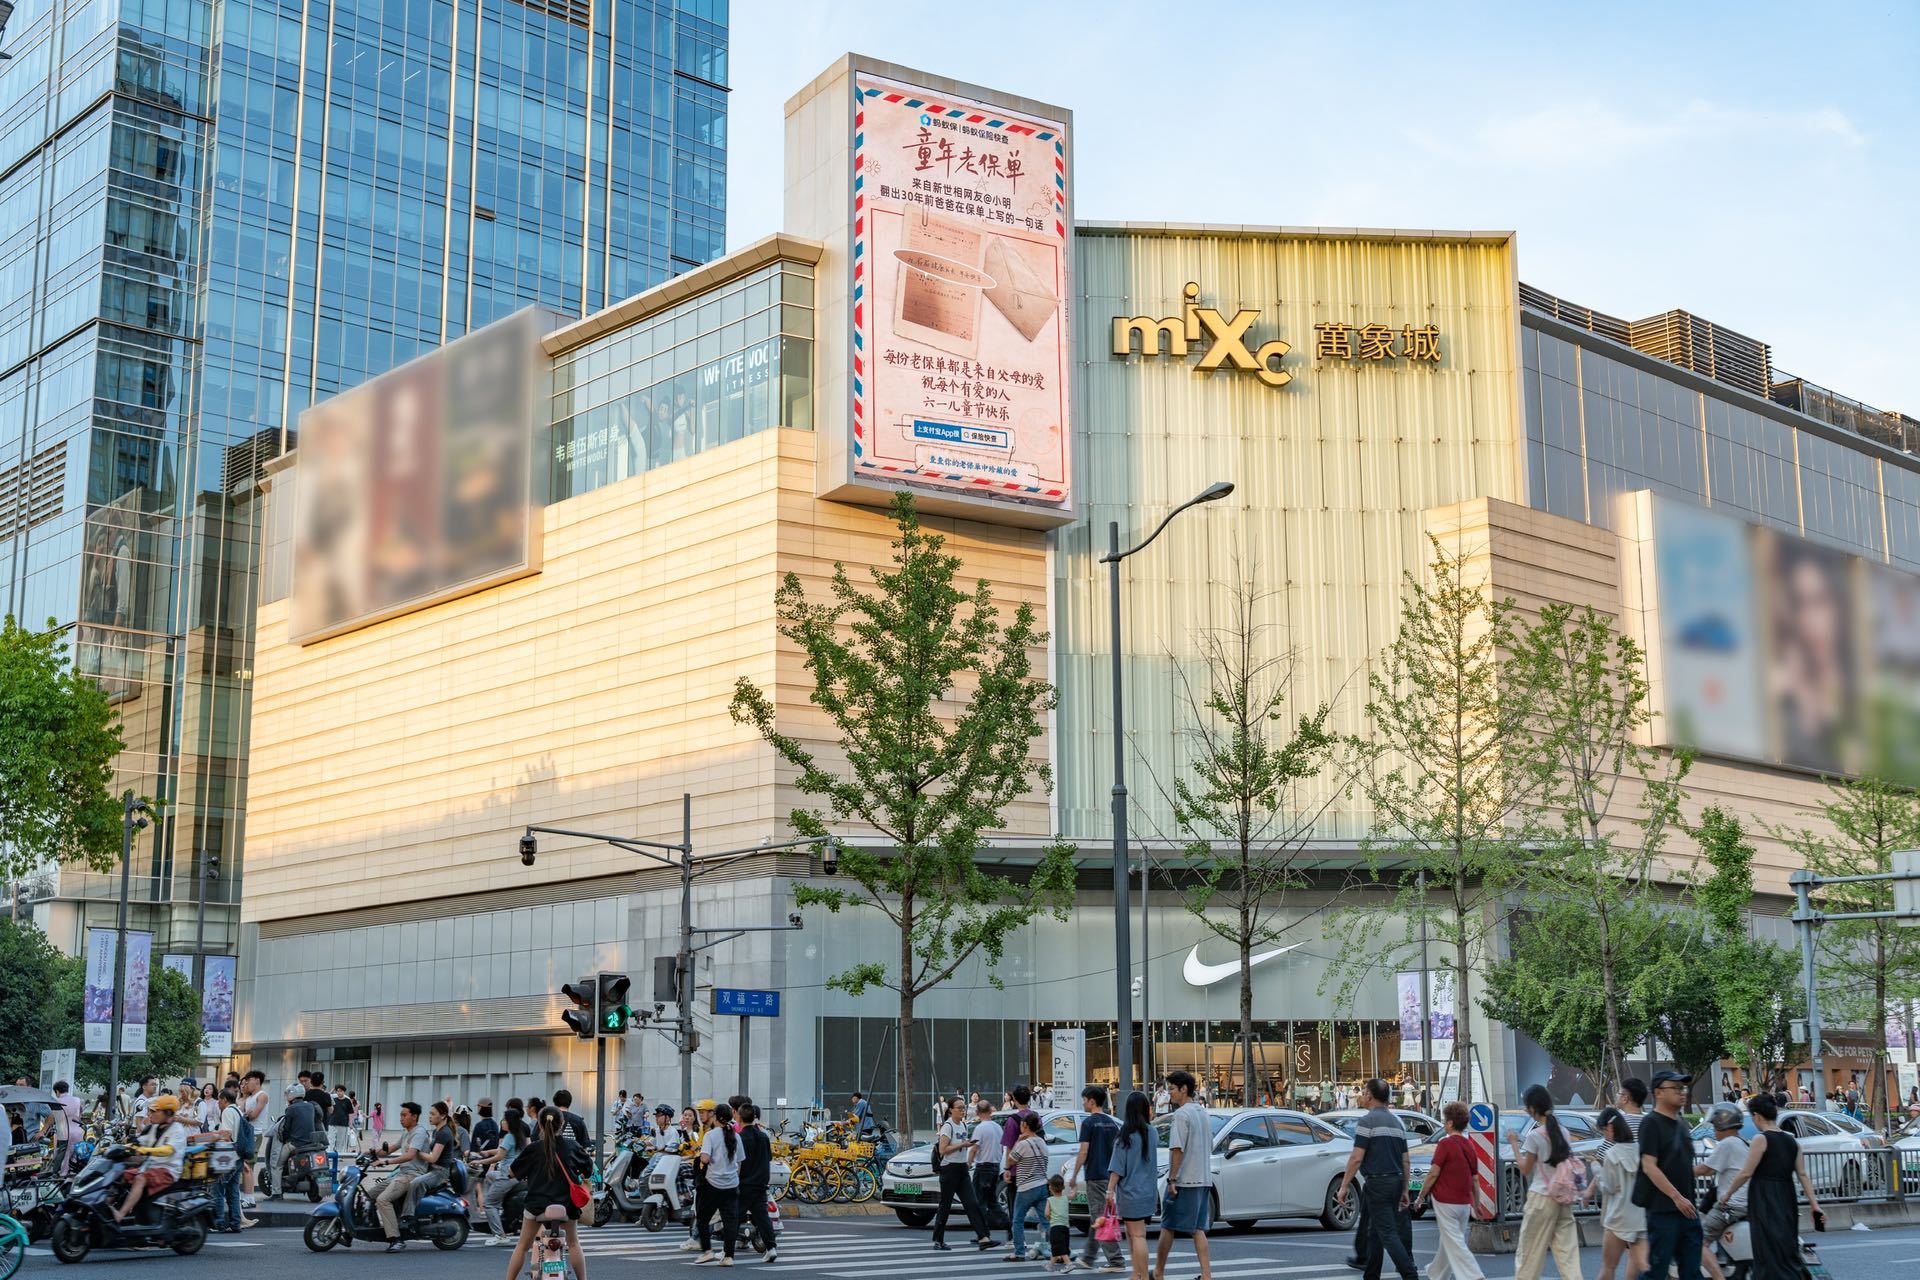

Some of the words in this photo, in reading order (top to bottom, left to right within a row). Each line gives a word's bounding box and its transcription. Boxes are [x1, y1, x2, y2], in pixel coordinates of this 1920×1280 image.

[903, 127, 1025, 195] 童年老保单
[912, 177, 1012, 208] 来自新世相网友@小明
[880, 184, 1044, 231] 翻出30年前爸爸在保单上写的一句话
[1314, 322, 1442, 362] 萬象城
[883, 348, 1045, 390] 每份老保单都是来自父母的爱
[921, 375, 1011, 401] 祝每个有爱的人
[923, 396, 1010, 420] 六一儿童节快乐
[971, 432, 997, 443] 保险快查
[722, 991, 774, 1006] 双福二路
[1844, 1046, 1857, 1057] FOR
